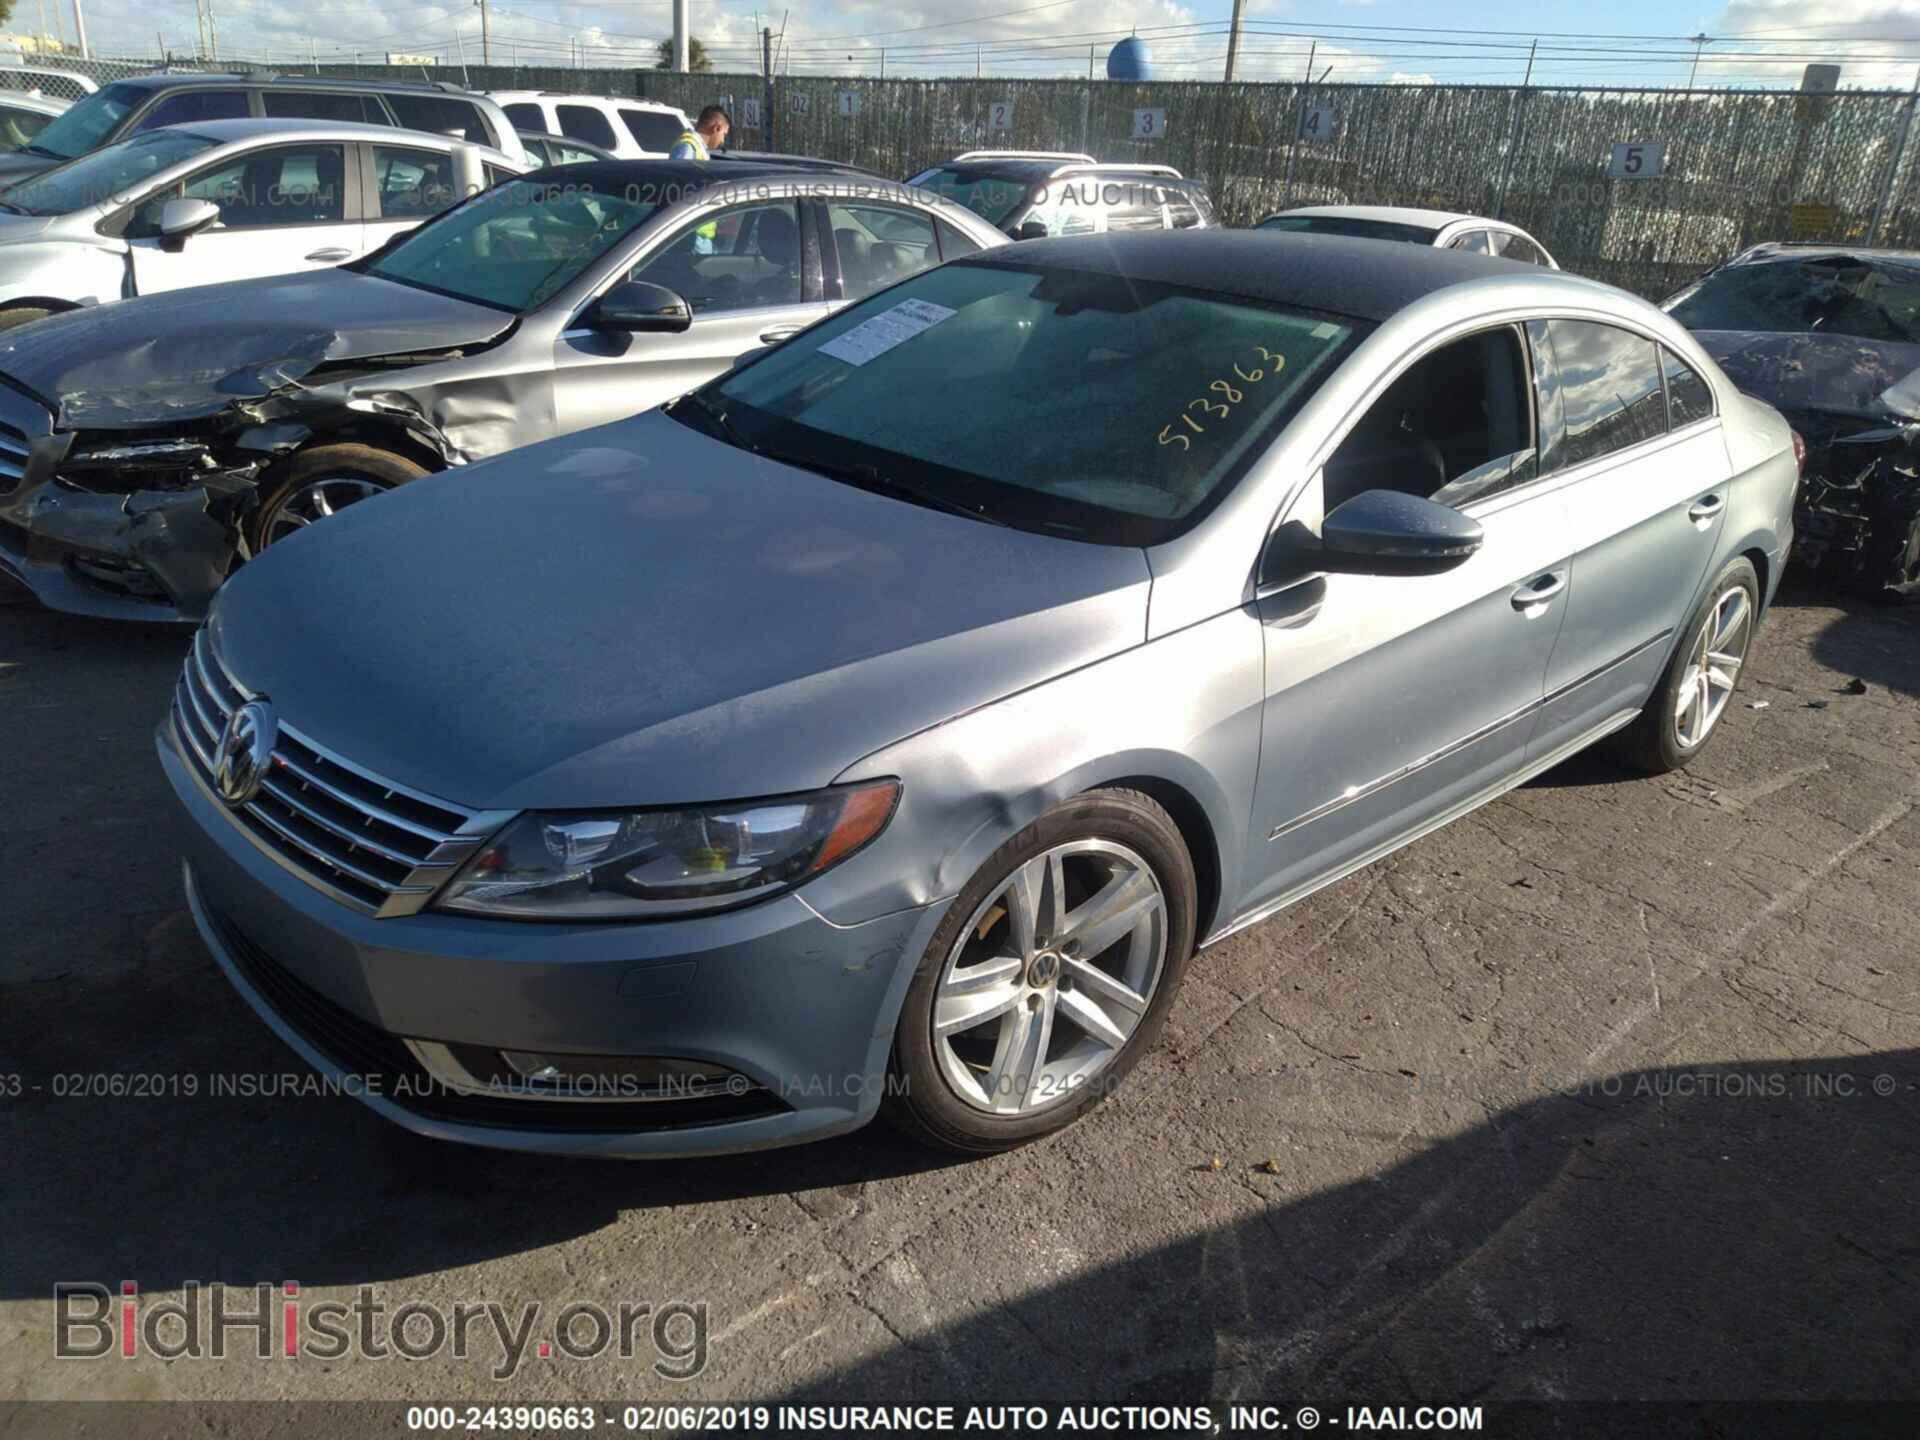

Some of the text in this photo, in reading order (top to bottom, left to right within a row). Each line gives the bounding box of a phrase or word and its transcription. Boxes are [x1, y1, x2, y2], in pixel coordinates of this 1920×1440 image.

[993, 106, 1005, 126] 2
[1142, 114, 1154, 133] 3
[1307, 111, 1320, 134] 4
[1624, 147, 1643, 174] 5
[1158, 347, 1286, 451] 513863
